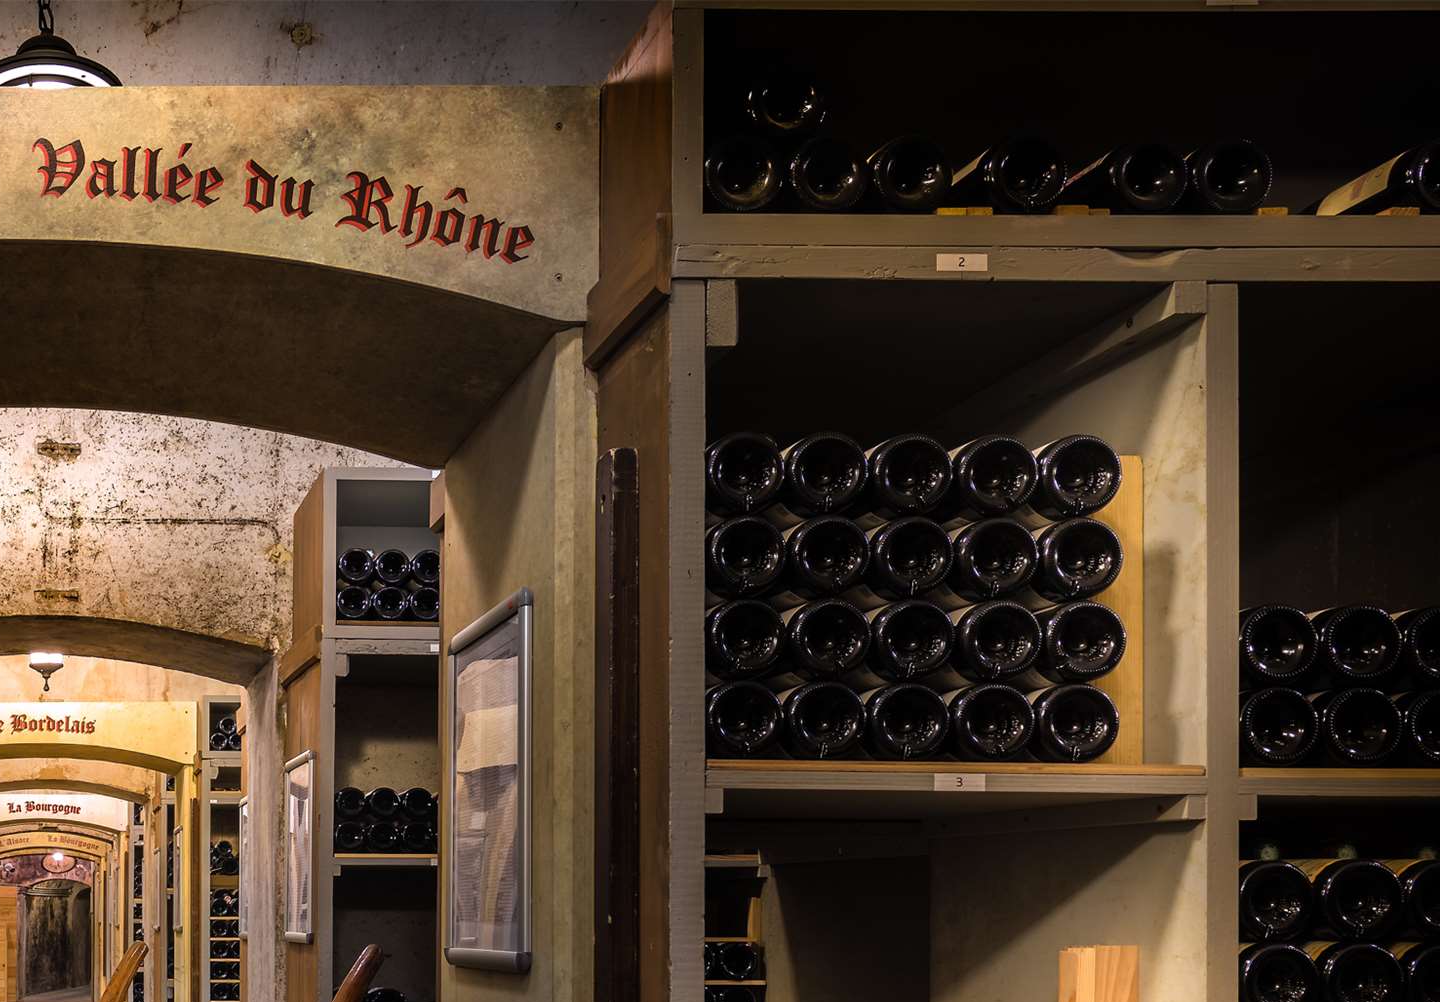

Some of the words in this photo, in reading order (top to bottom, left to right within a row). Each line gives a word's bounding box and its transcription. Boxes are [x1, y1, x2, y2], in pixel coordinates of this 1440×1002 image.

[32, 137, 224, 208] Vallée
[243, 159, 316, 220] du
[335, 171, 535, 265] Rhône
[958, 257, 965, 267] 2
[10, 713, 96, 735] Bordelais
[956, 777, 963, 787] 3
[7, 802, 21, 814] La
[25, 801, 82, 816] Bourgogne
